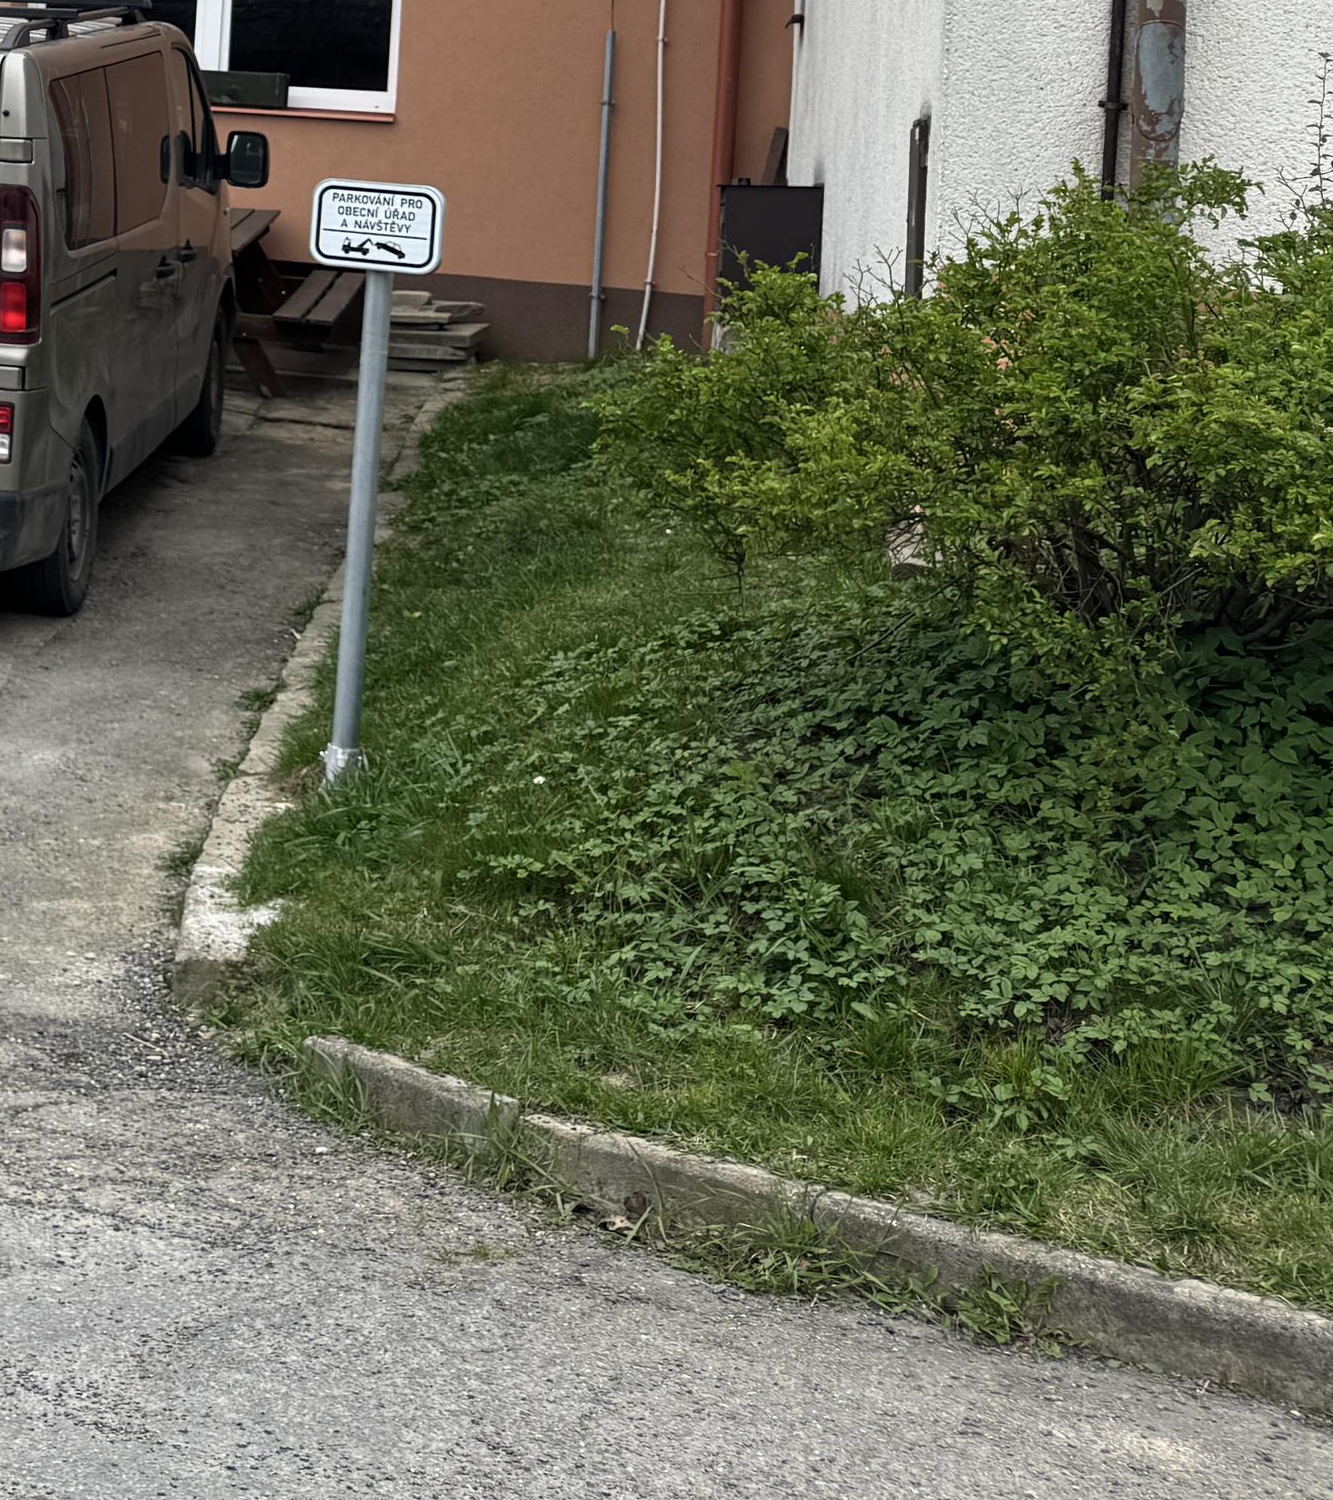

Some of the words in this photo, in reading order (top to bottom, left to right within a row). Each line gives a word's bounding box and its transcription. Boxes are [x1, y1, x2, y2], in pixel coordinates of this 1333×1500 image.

[332, 192, 395, 207] PARKOVÁNÍ
[400, 198, 423, 209] PRO
[337, 206, 379, 218] OBECNÍ
[384, 207, 416, 221] ÚŘAD
[340, 218, 348, 228] A
[354, 219, 411, 233] NÁVŠTĚVY
